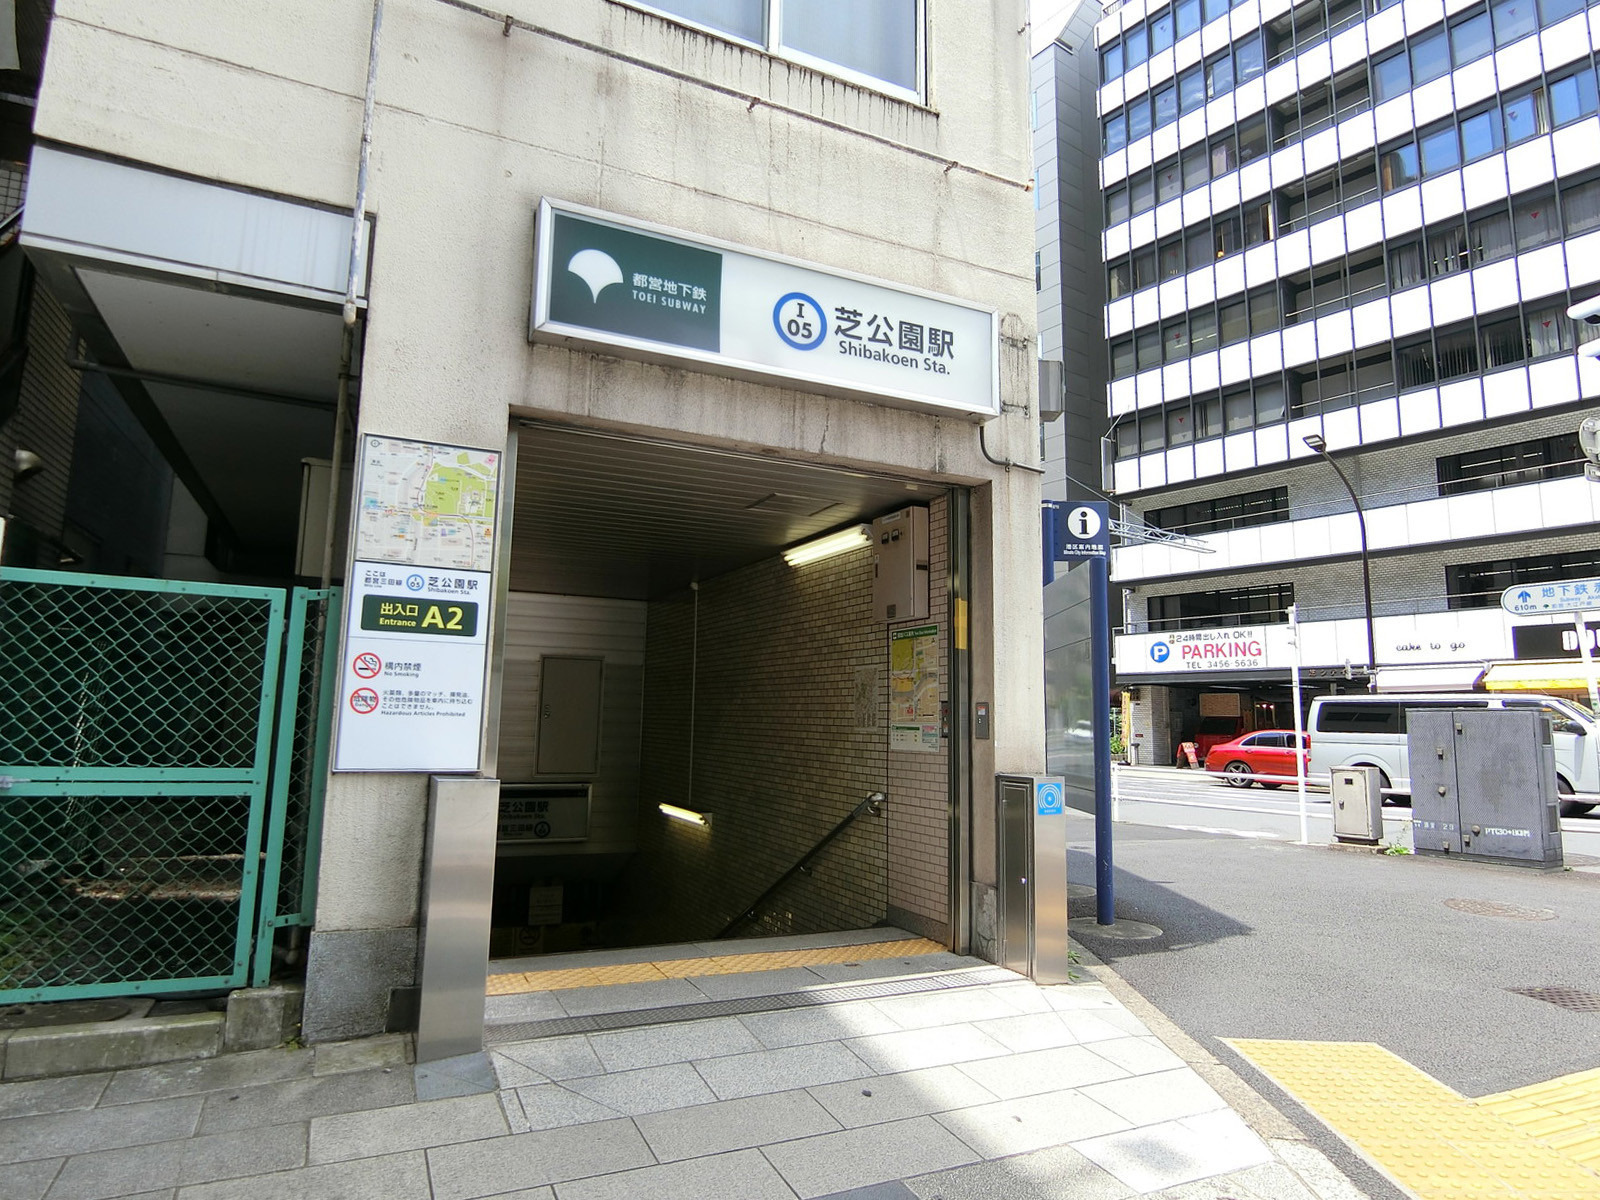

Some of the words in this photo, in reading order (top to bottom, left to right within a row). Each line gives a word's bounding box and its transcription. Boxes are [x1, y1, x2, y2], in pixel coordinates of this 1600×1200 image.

[633, 272, 707, 303] 都営地下鉄
[632, 290, 657, 305] TOEI
[661, 295, 707, 315] SUBWAY
[796, 303, 805, 318] I
[787, 319, 814, 340] 05
[834, 306, 955, 360] 芝公園駅
[838, 339, 919, 370] Shibakoen
[923, 357, 951, 376] Sta.
[428, 577, 478, 590] 芝公園駅
[1514, 602, 1537, 611] 610m
[379, 617, 417, 627] Entrance
[380, 603, 419, 617] 出入口
[421, 605, 463, 630] A2
[1182, 641, 1262, 660] PARKING
[1396, 643, 1421, 651] cake
[1430, 642, 1441, 650] to
[1450, 642, 1466, 651] go
[385, 662, 422, 671] 構内禁煙
[1186, 661, 1202, 669] TEL
